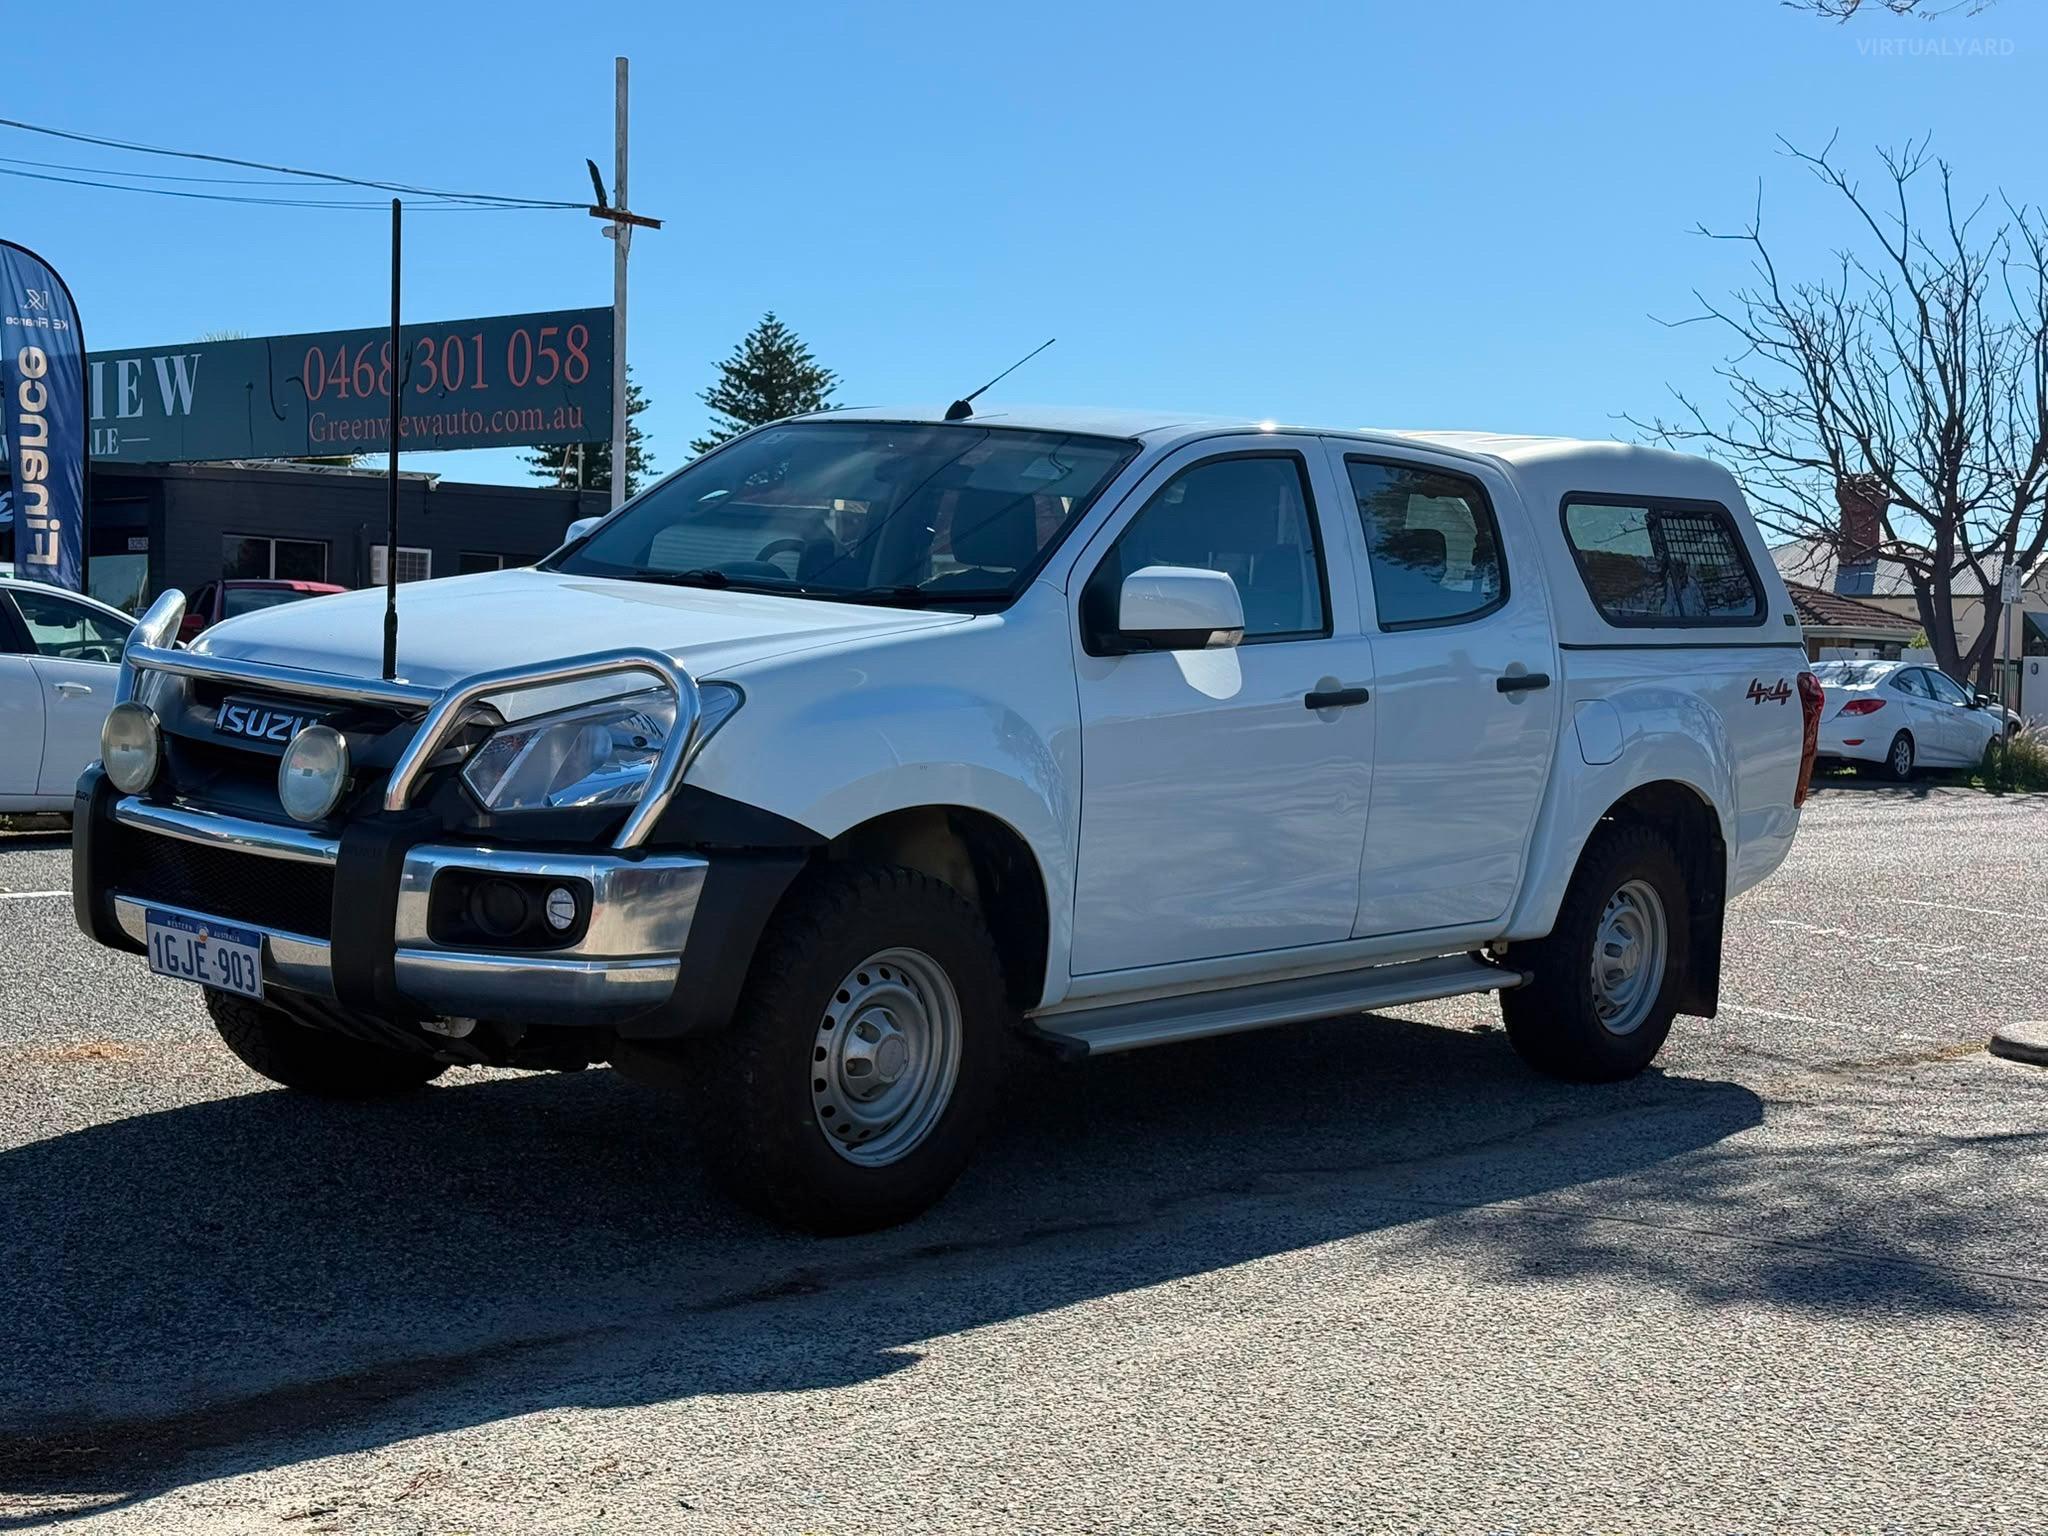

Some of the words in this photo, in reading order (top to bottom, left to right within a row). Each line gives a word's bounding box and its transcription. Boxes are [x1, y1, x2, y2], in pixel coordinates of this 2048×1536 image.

[303, 341, 394, 400] 0468
[416, 333, 489, 394] 301
[507, 325, 590, 388] 058
[309, 406, 584, 442] Greenvewauto.com.au
[1745, 677, 1793, 706] 4x4
